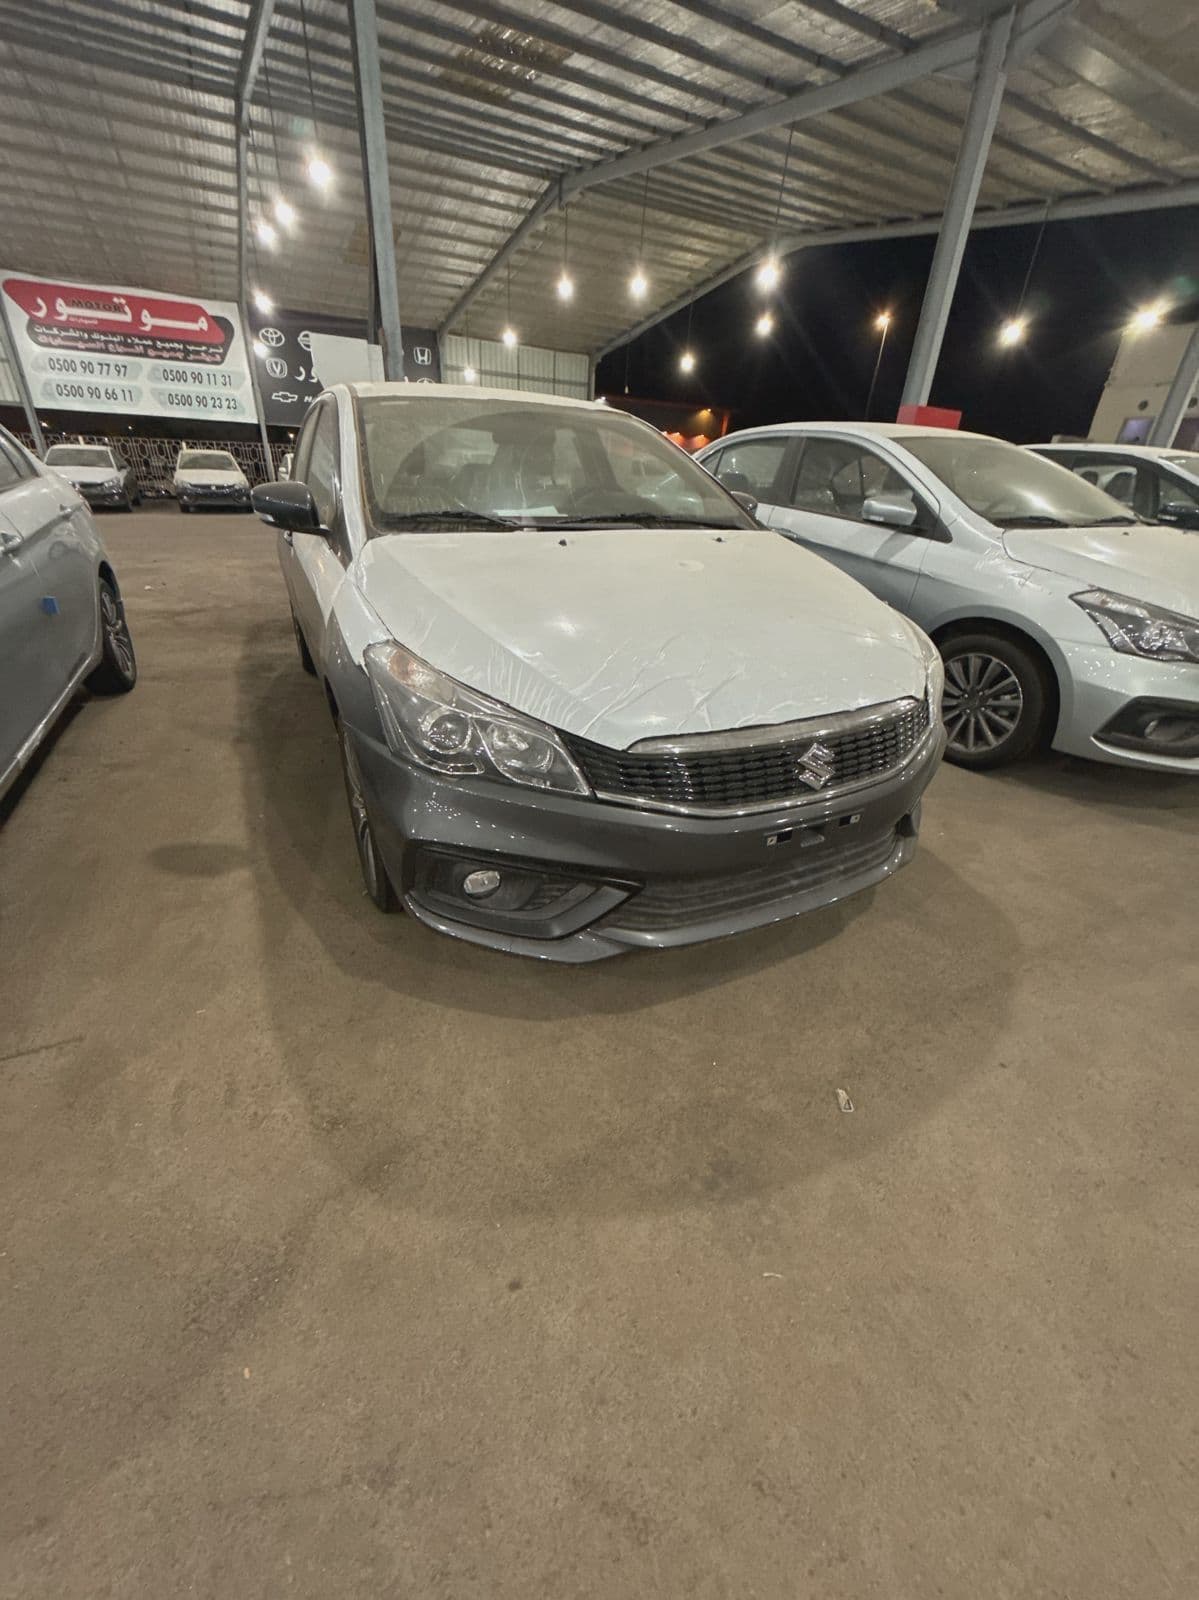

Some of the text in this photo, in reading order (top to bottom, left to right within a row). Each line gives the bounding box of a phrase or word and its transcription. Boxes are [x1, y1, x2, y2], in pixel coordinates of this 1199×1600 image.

[71, 299, 121, 313] MOTOR
[34, 326, 89, 340] والشركات
[91, 331, 125, 342] البنوك
[48, 357, 128, 377] 0500 90 77 97
[162, 369, 232, 387] 0500 90 11 31
[55, 383, 133, 402] 0500 90 66 11
[167, 393, 238, 410] 0500 90 23 23
